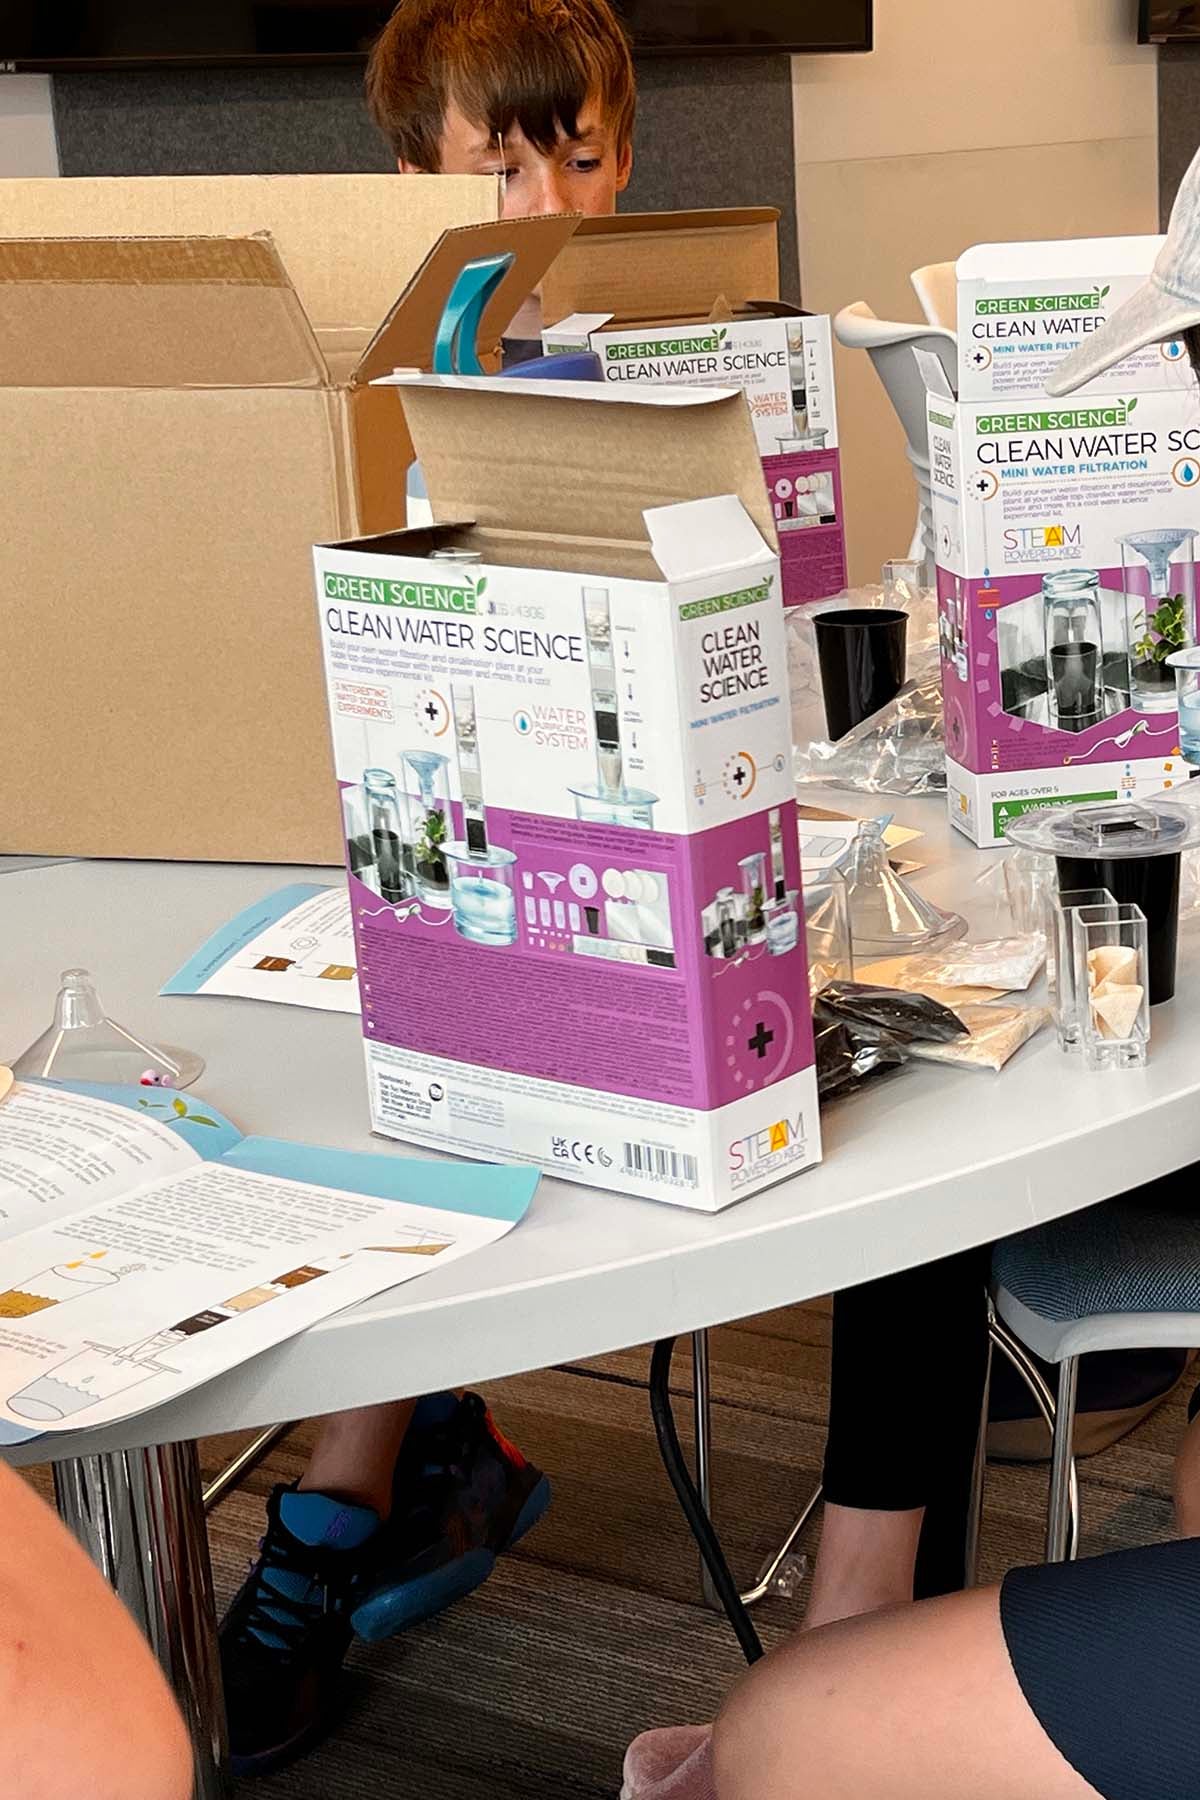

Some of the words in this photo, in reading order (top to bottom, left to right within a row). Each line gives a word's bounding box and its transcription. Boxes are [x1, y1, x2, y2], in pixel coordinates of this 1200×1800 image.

[976, 298, 1030, 313] GREEN
[1034, 295, 1099, 310] SCIENCE
[972, 320, 1036, 339] CLEAN
[607, 342, 658, 359] GREEN
[660, 338, 718, 355] SCIENCE
[993, 345, 1015, 353] MINI
[1018, 342, 1053, 352] WATER
[606, 362, 661, 382] CLEAN
[663, 357, 718, 376] WATER
[723, 351, 786, 371] SCIENCE
[753, 392, 787, 403] WATER
[755, 406, 788, 418] SYSTEM
[977, 412, 1045, 433] GREEN
[1048, 407, 1127, 429] SCIENCE
[977, 439, 1063, 465] CLEAN
[1070, 433, 1157, 460] WATER
[1001, 468, 1028, 479] MINI
[1032, 464, 1077, 477] WATER
[1079, 460, 1148, 474] FILTRATION
[1002, 489, 1022, 498] Build
[1024, 489, 1039, 497] your
[1112, 482, 1126, 490] and
[1003, 525, 1081, 550] STEAM
[325, 576, 385, 603] GREEN
[390, 583, 476, 611] SCIENCE
[680, 598, 722, 620] GREEN
[723, 588, 771, 609] SCIENCE
[326, 607, 392, 641] CLEAN
[396, 616, 475, 650] WATER
[483, 626, 585, 663] SCIENCE
[701, 620, 761, 655] CLEAN
[703, 644, 762, 678] WATER
[700, 666, 769, 704] SCIENCE
[532, 704, 586, 726] WATER
[535, 730, 589, 751] SYSTEM
[991, 790, 1007, 799] FOR
[1009, 788, 1030, 798] AGES
[1031, 786, 1053, 796] OVER
[729, 1111, 804, 1171] STEAM
